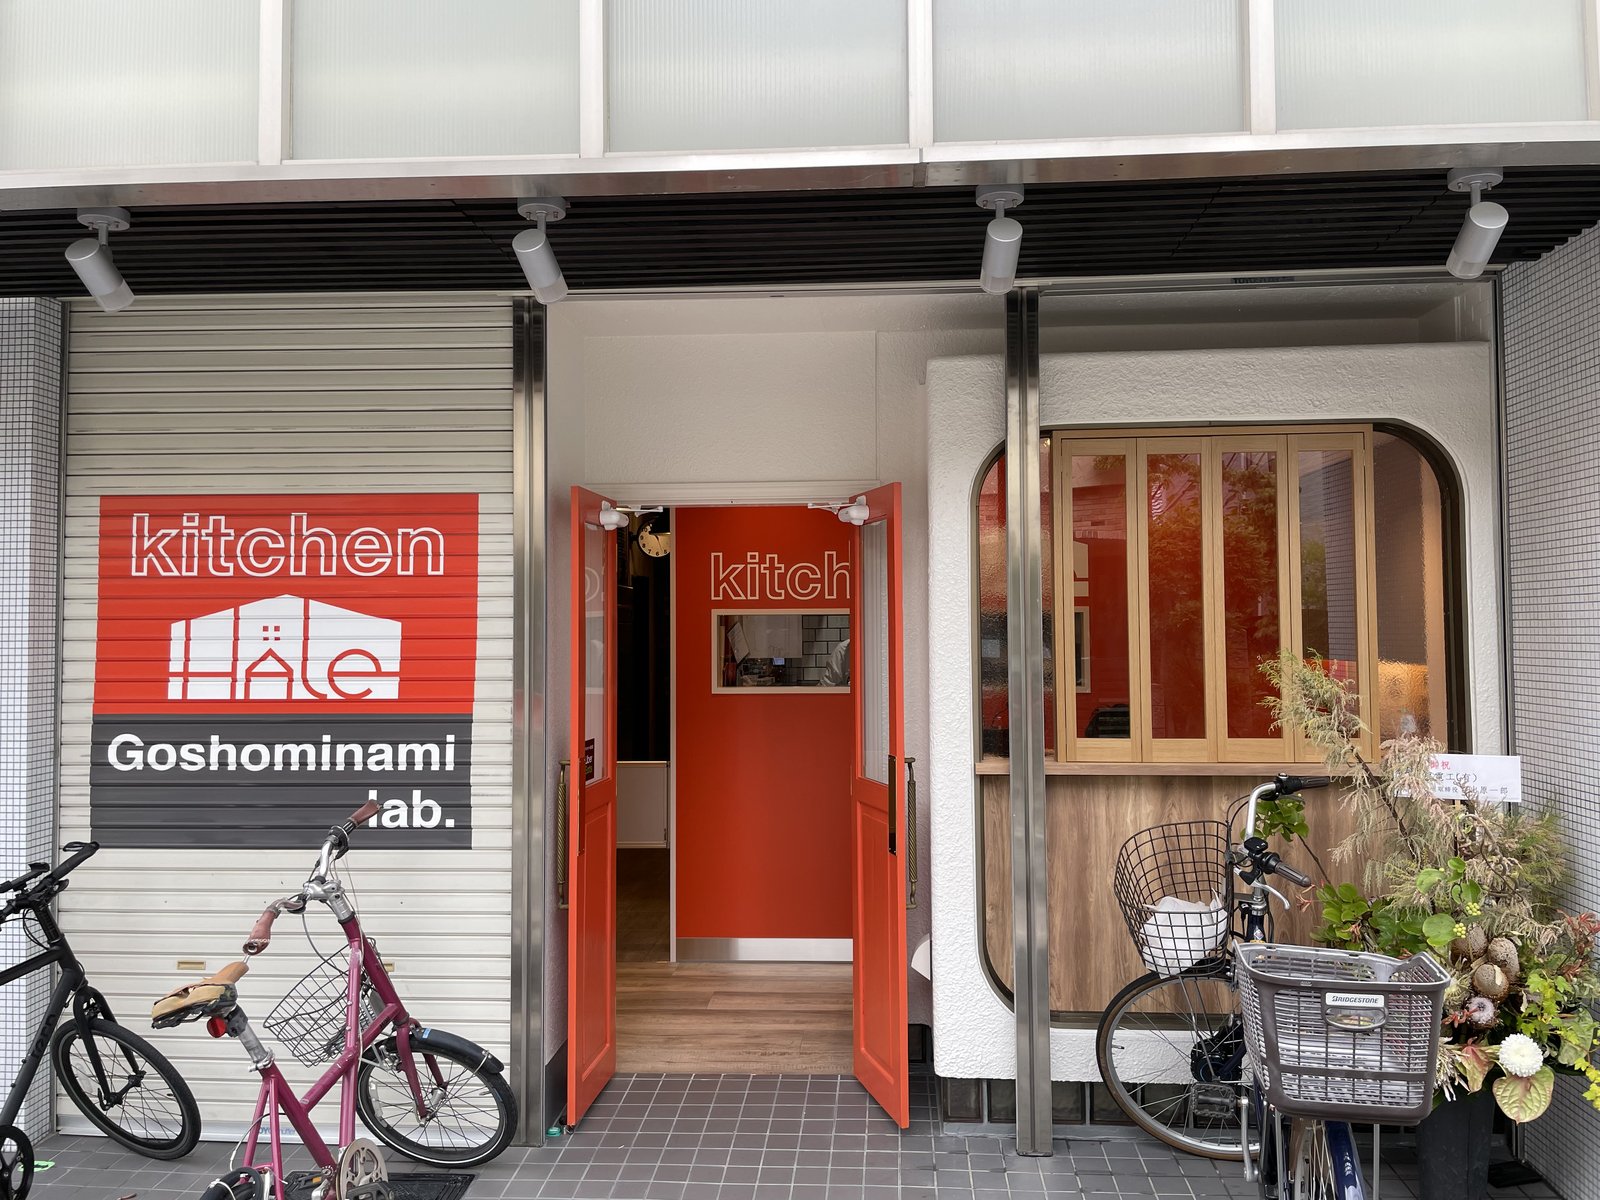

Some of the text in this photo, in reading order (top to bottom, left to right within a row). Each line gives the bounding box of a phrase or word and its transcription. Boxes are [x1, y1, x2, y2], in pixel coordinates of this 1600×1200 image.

[131, 512, 445, 577] kitchen
[107, 733, 456, 771] Goshominami
[368, 789, 455, 828] lab.
[1332, 995, 1379, 1004] BRIDGESTONE
